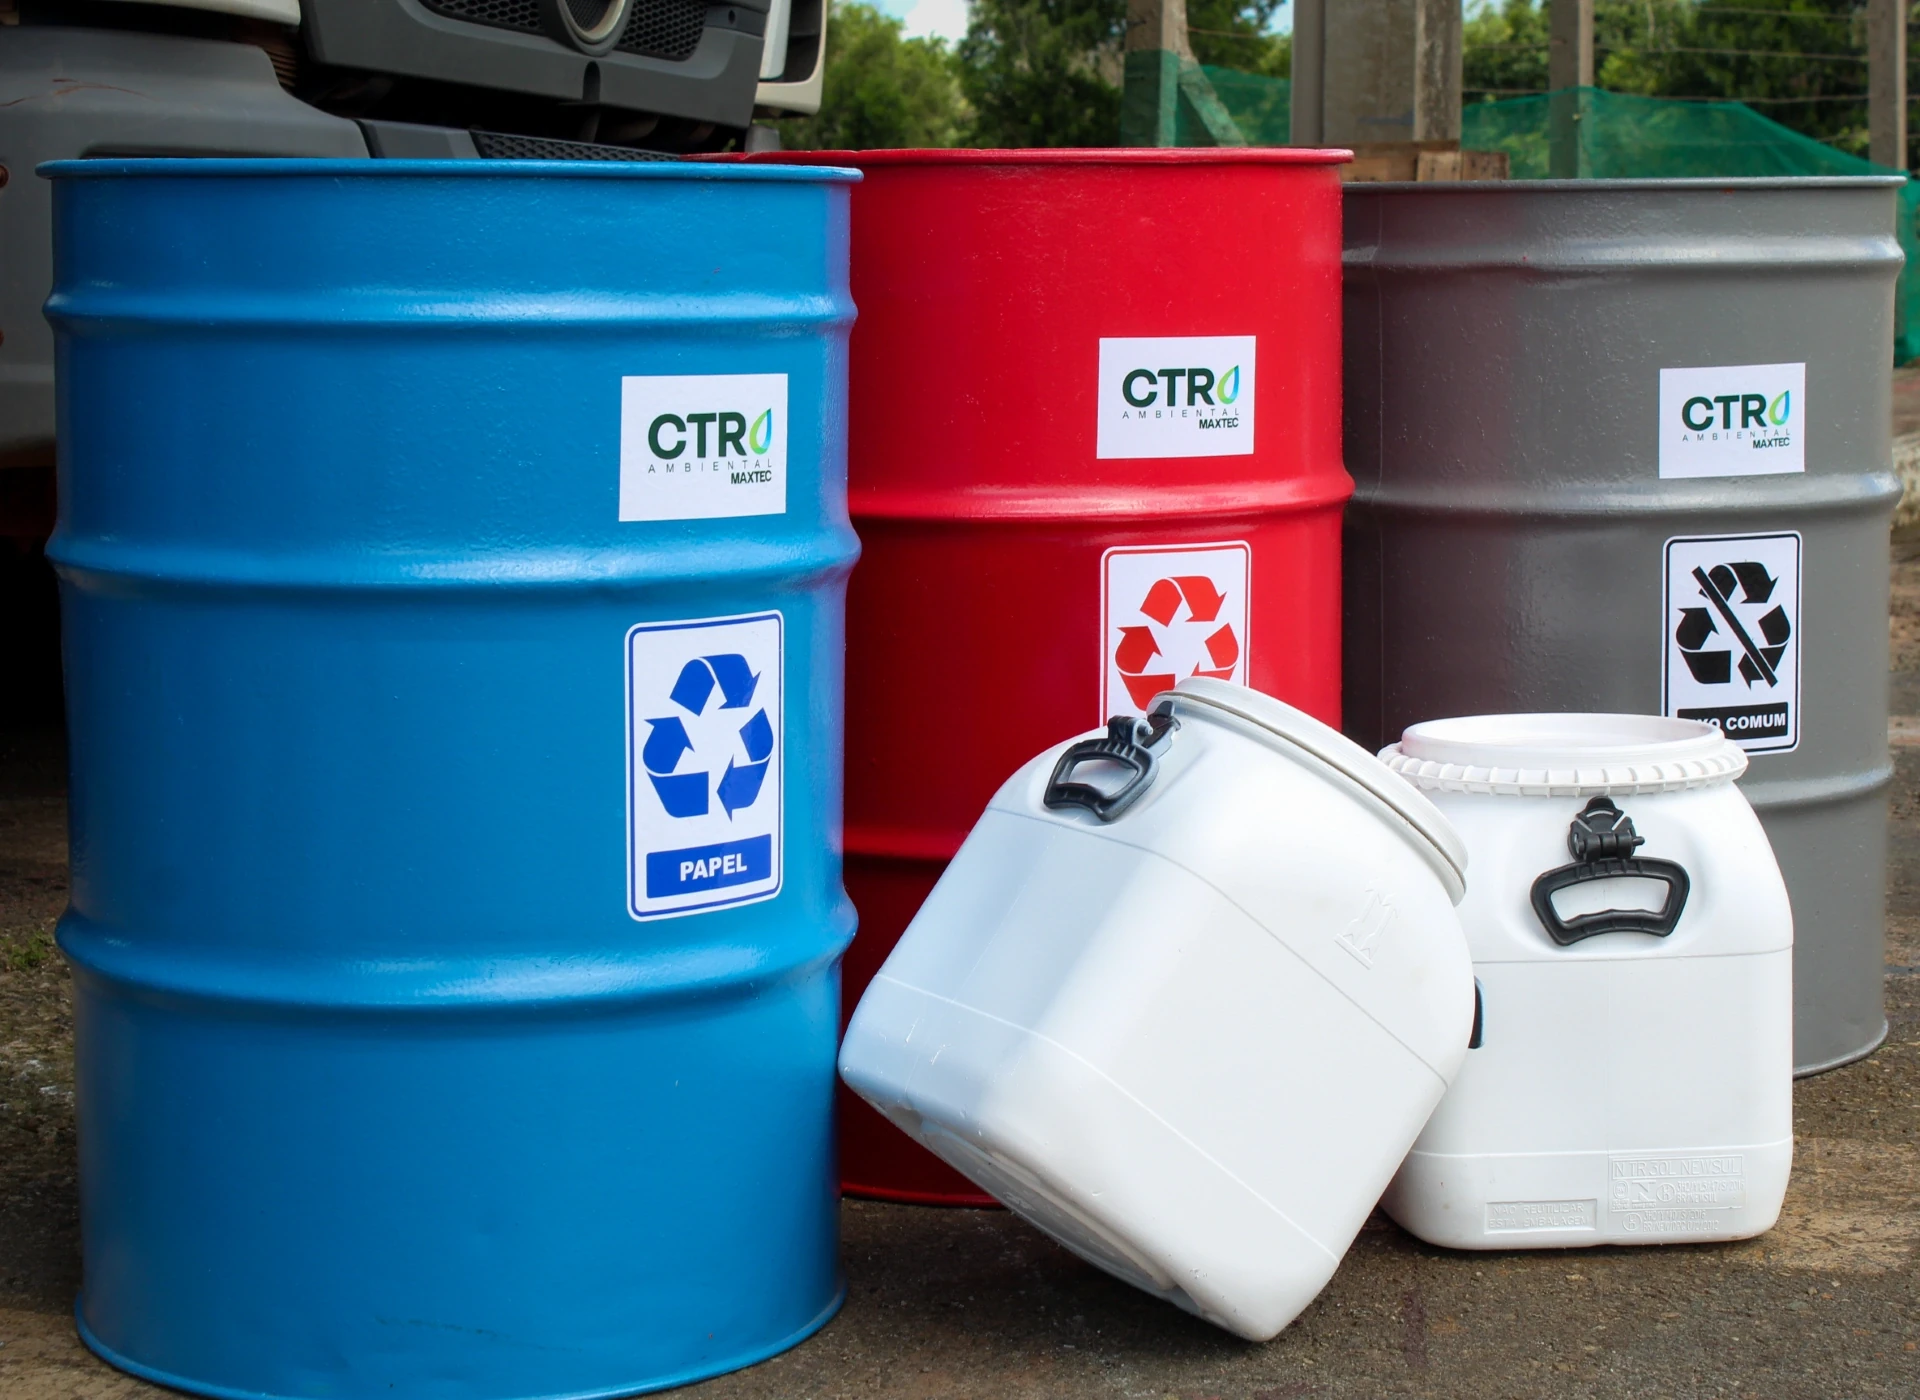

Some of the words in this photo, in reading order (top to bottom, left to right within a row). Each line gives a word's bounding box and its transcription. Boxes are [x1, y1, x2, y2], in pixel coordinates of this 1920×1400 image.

[1122, 368, 1215, 408] CTR
[1122, 408, 1239, 420] AMBIENTAL
[1682, 393, 1767, 431] CTR
[1199, 417, 1239, 429] MAXTEC
[648, 412, 747, 460] CTR
[1682, 428, 1790, 442] AMBIENTAL
[1753, 437, 1790, 449] MAXTEC
[648, 458, 772, 474] AMBIENTAL
[731, 470, 772, 485] MAXTEC
[1726, 713, 1786, 731] COMUM
[680, 853, 748, 882] PAPEL
[1680, 1158, 1740, 1176] NEWSUL
[1523, 1202, 1585, 1214] REUTILIZAR
[1489, 1217, 1517, 1229] ESTA
[1523, 1215, 1588, 1228] EMBALAGEM
